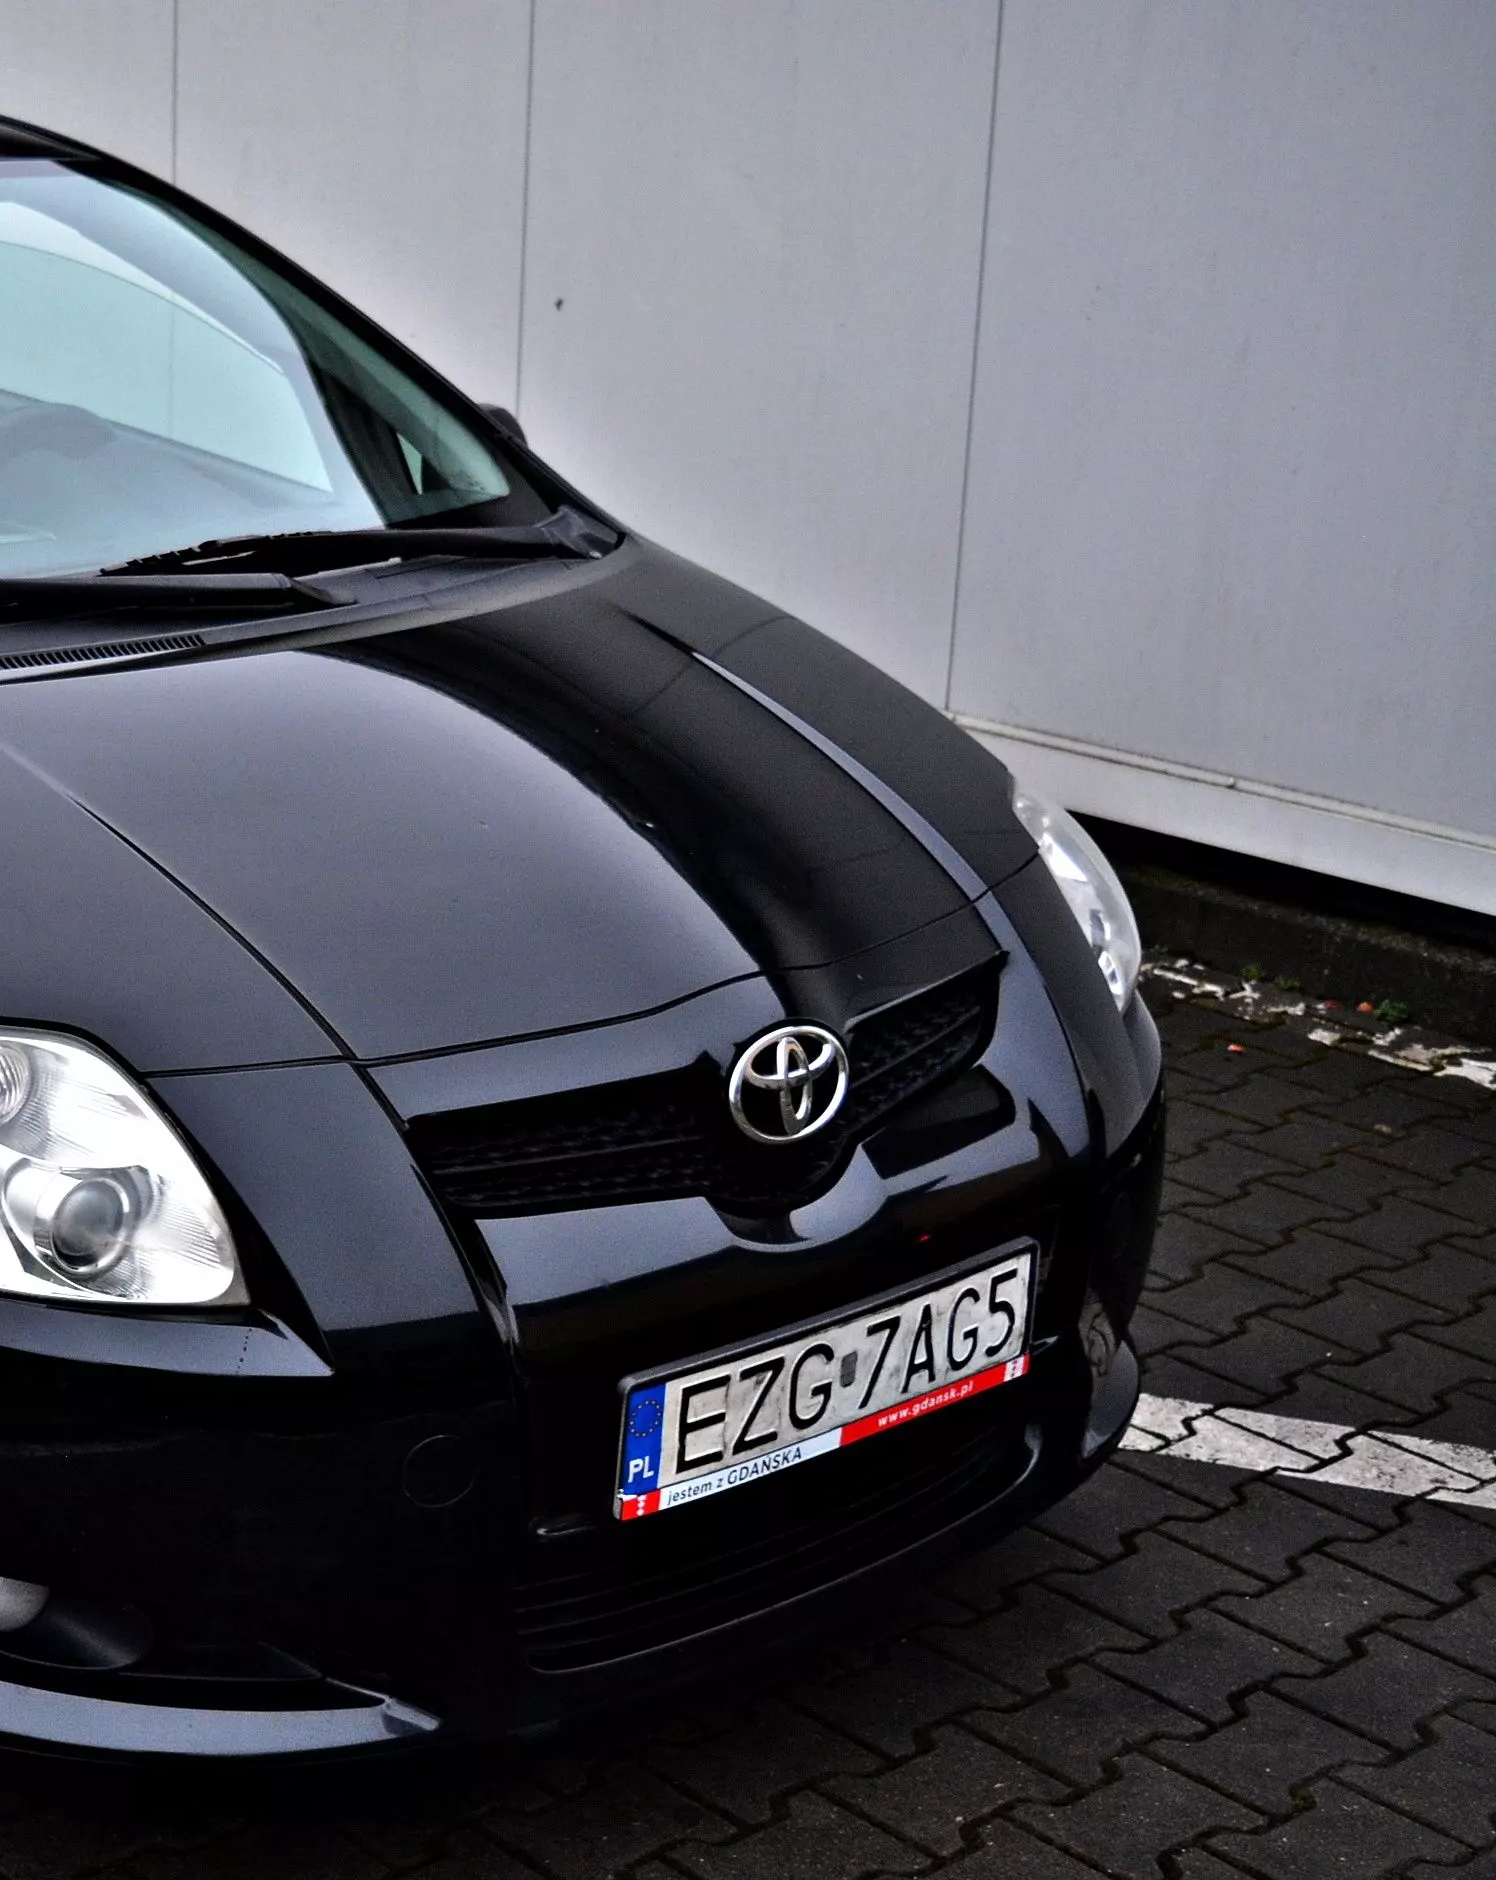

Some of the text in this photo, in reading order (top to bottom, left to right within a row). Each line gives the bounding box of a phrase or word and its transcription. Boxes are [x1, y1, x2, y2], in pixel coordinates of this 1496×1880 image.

[676, 1268, 1019, 1474] EZG 7AG5
[878, 1380, 974, 1427] www.gdansk.pl
[628, 1456, 654, 1483] PL
[667, 1480, 713, 1505] jestem
[716, 1478, 724, 1488] z
